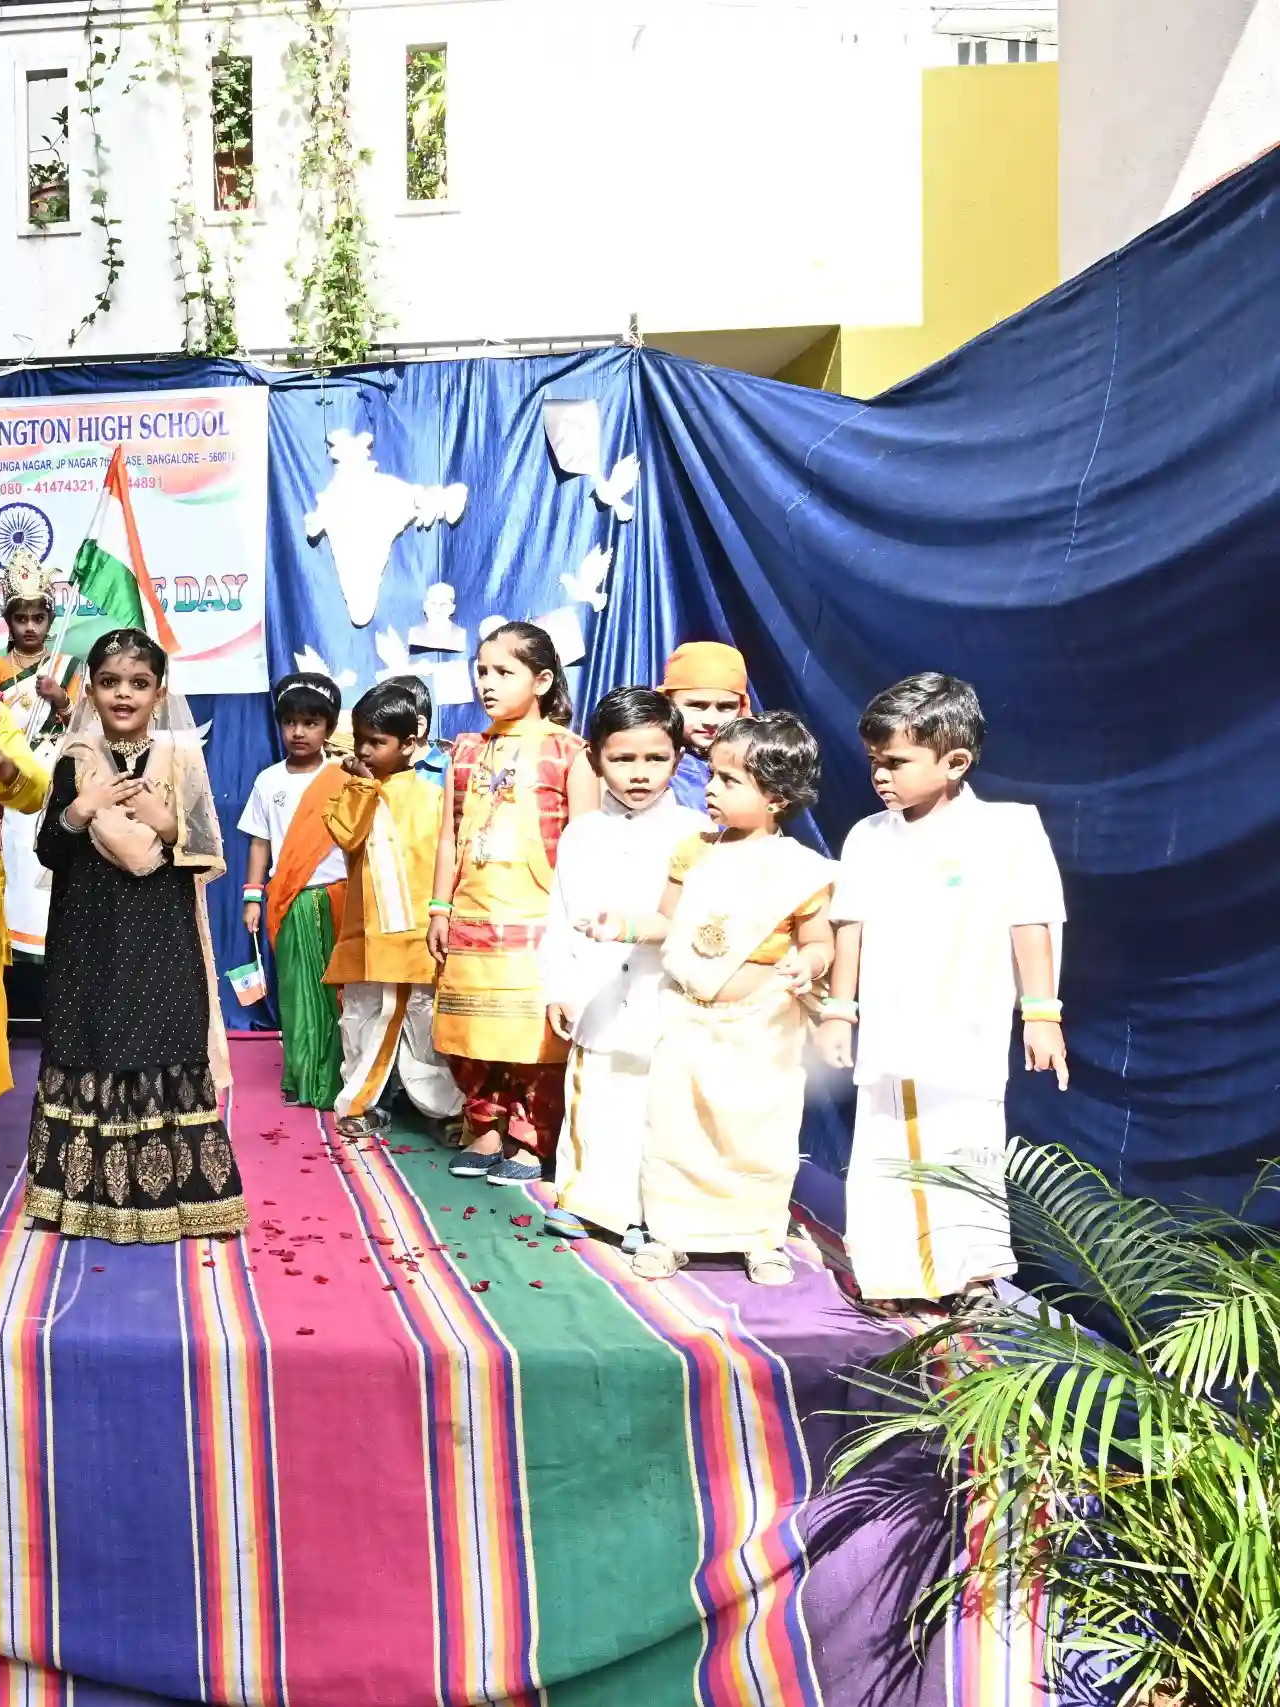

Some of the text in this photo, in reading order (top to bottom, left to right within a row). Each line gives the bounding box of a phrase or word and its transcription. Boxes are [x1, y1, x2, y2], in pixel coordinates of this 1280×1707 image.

[78, 415, 133, 442] HIGH
[139, 411, 230, 440] SCHOOL
[22, 459, 54, 472] NAGAR,
[56, 458, 66, 469] JP
[68, 457, 98, 468] NAGAR
[146, 452, 200, 465] BANGALORE
[0, 482, 22, 496] 080
[173, 573, 249, 613] DAY
